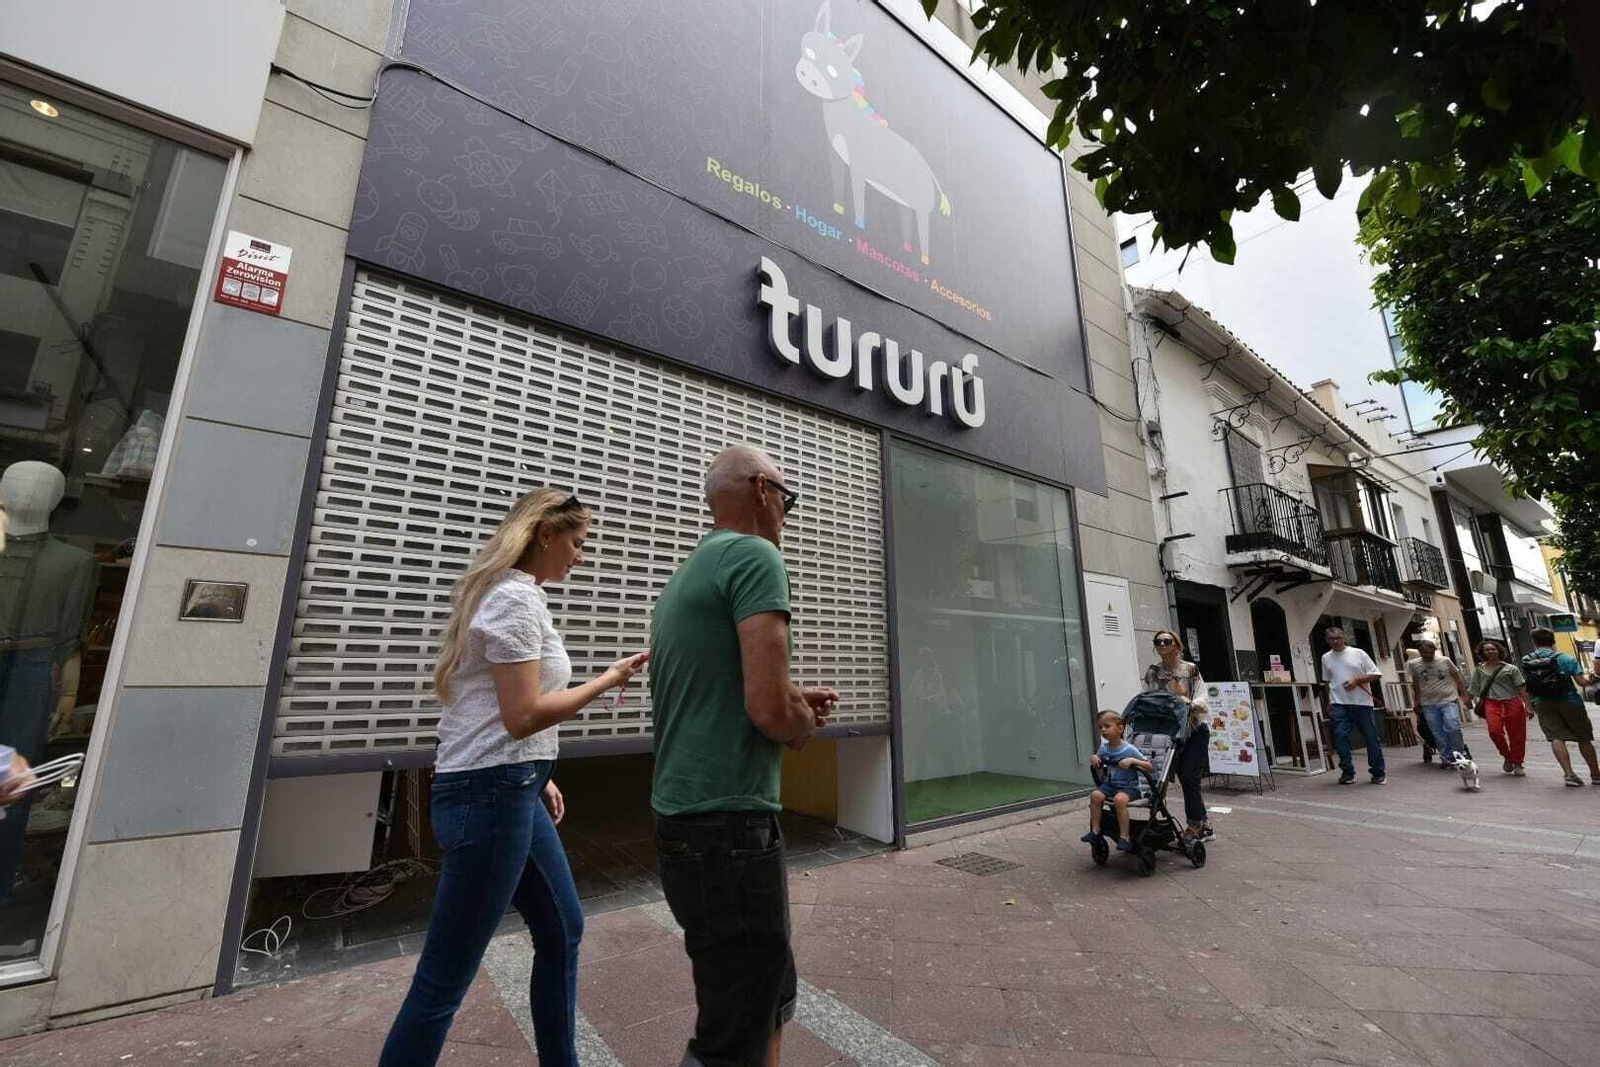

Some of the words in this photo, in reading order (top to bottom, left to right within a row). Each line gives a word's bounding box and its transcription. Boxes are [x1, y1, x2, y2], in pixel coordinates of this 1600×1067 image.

[706, 156, 783, 210] Regalos
[794, 204, 843, 240] Hogar
[855, 237, 920, 283] Mascotas
[930, 278, 993, 322] Accesorios
[226, 266, 281, 287] Zerovision
[236, 262, 274, 278] Alarma
